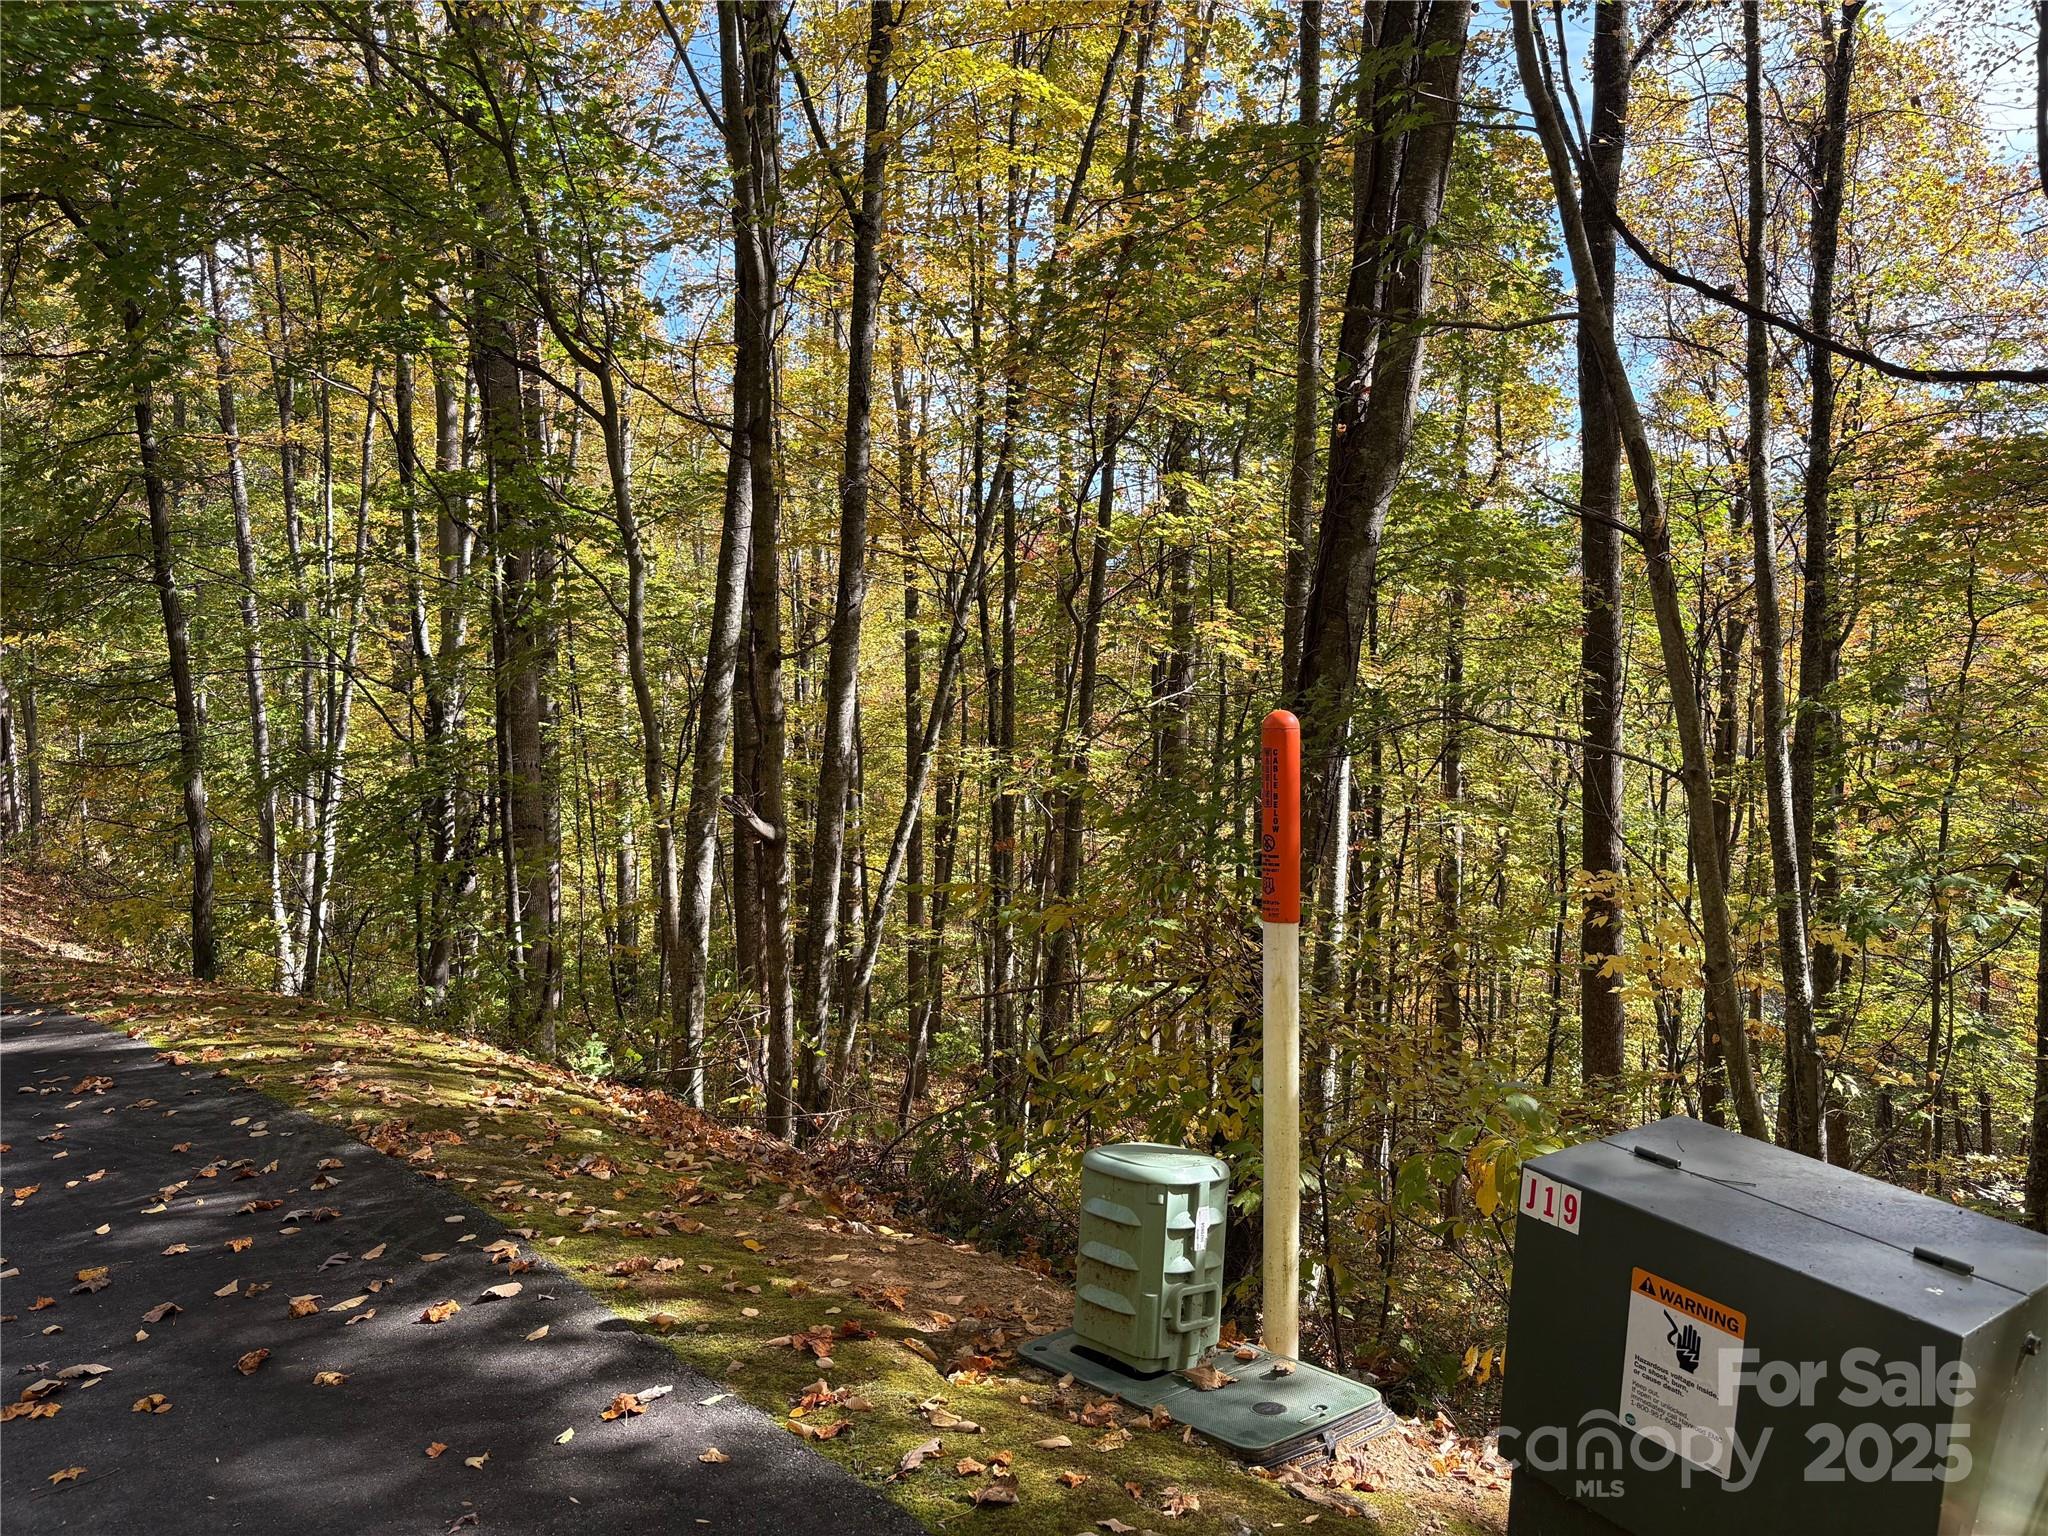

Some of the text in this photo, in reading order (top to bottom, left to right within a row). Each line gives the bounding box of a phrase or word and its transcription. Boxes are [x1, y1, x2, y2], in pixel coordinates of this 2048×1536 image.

[1272, 792, 1280, 833] BELOW
[1660, 1285, 1740, 1333] WARNING
[1632, 1379, 1647, 1391] Keep
[1633, 1368, 1684, 1397] or cause death.
[1634, 1354, 1669, 1375] Hazardous
[1670, 1372, 1695, 1388] voltage
[1634, 1361, 1689, 1393] Can shock, burn,
[1630, 1393, 1666, 1416] immediately
[1667, 1411, 1678, 1421] call
[1637, 1390, 1652, 1401] open
